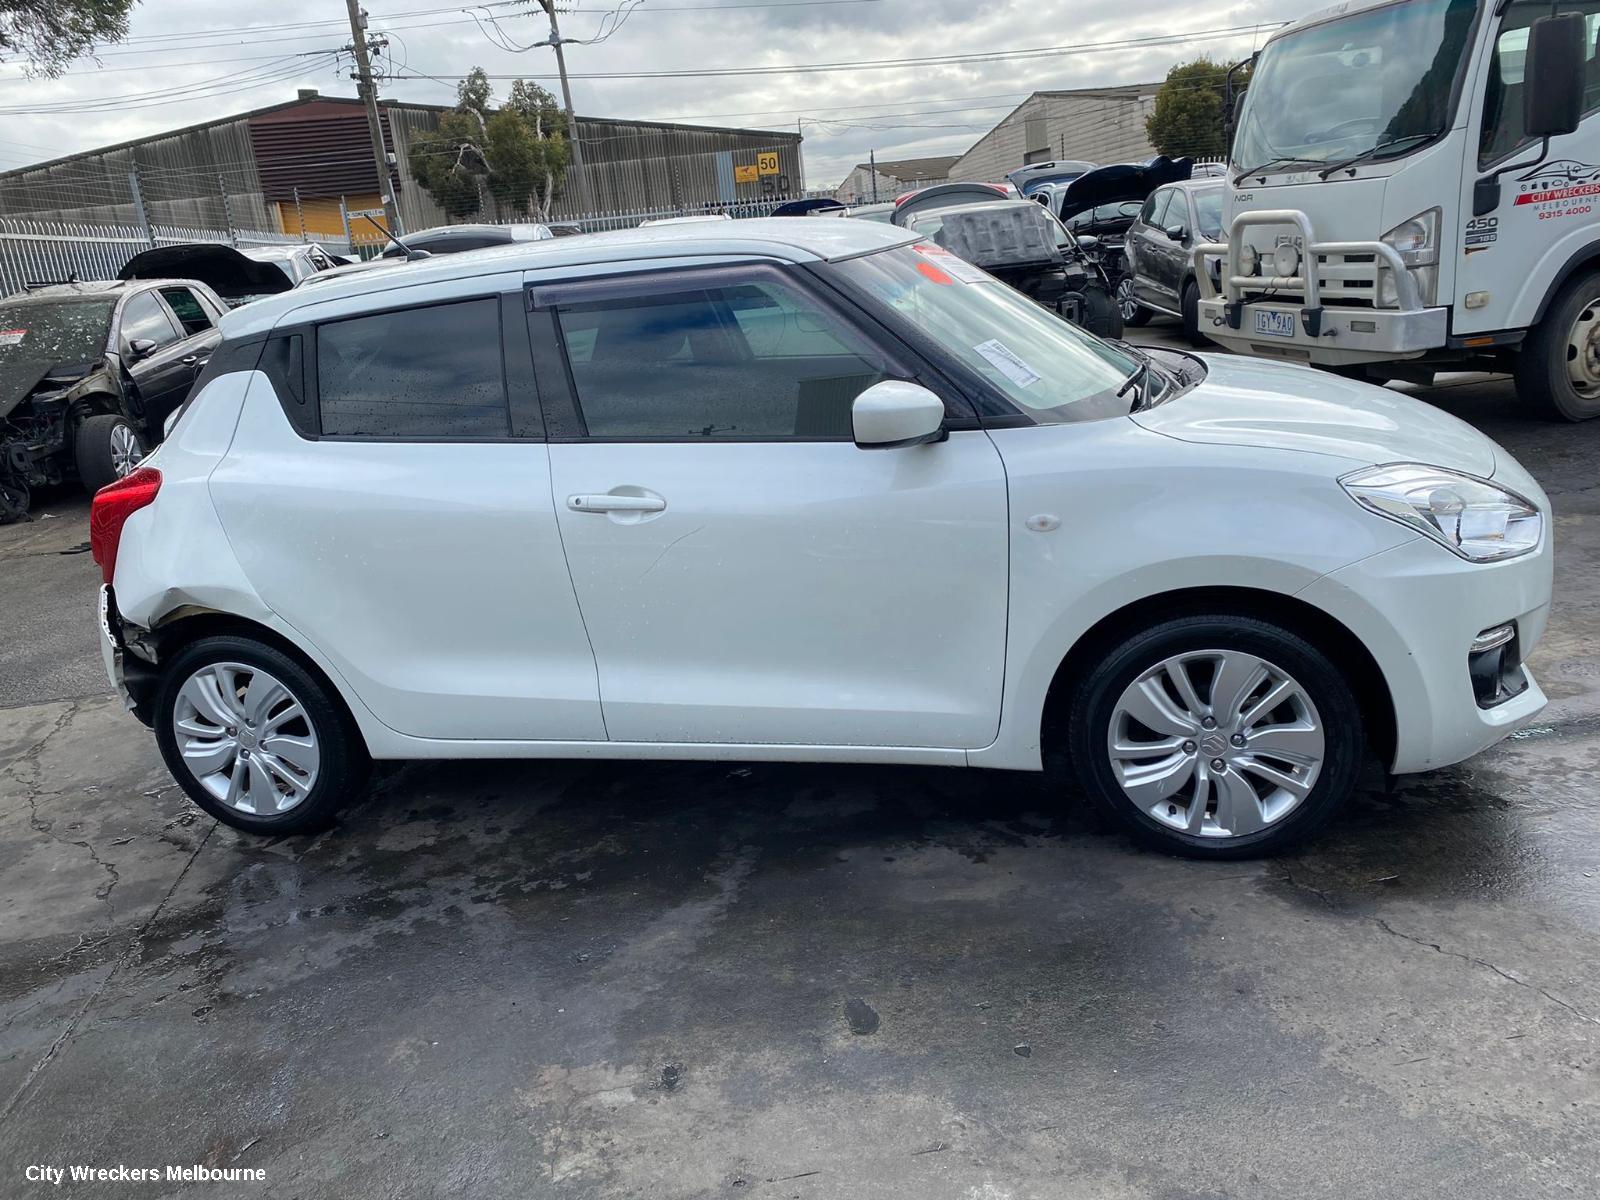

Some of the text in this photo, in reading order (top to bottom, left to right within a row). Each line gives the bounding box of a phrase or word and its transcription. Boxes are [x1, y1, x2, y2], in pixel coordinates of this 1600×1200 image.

[760, 157, 776, 170] 50
[1531, 184, 1600, 202] CITY WRECKERS
[1533, 195, 1600, 211] MELBOURNE
[1538, 205, 1592, 220] 9315 4000
[1466, 217, 1498, 229] 450
